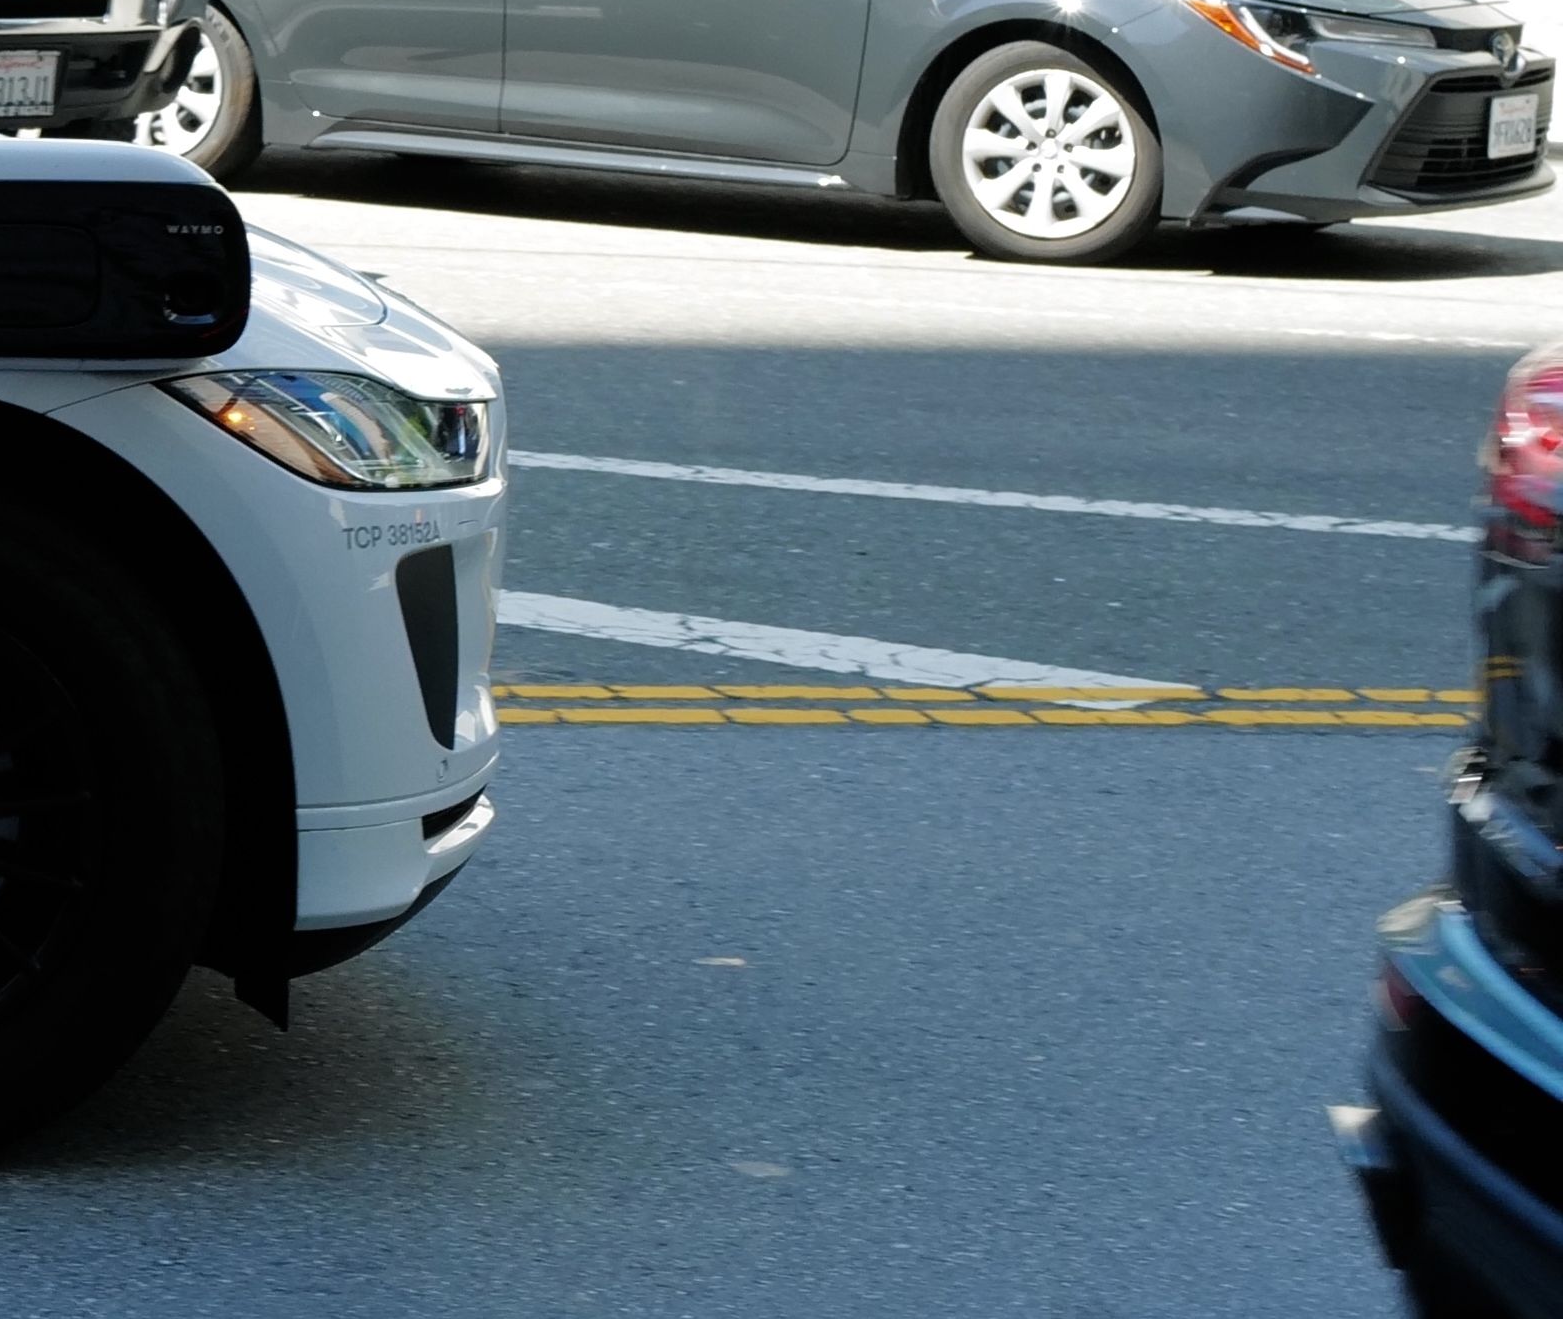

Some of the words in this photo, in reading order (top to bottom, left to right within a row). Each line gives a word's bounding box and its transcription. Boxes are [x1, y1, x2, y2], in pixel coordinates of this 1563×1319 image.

[165, 224, 225, 235] WAYMO
[341, 525, 383, 550] TCP
[387, 520, 441, 547] 38152A
